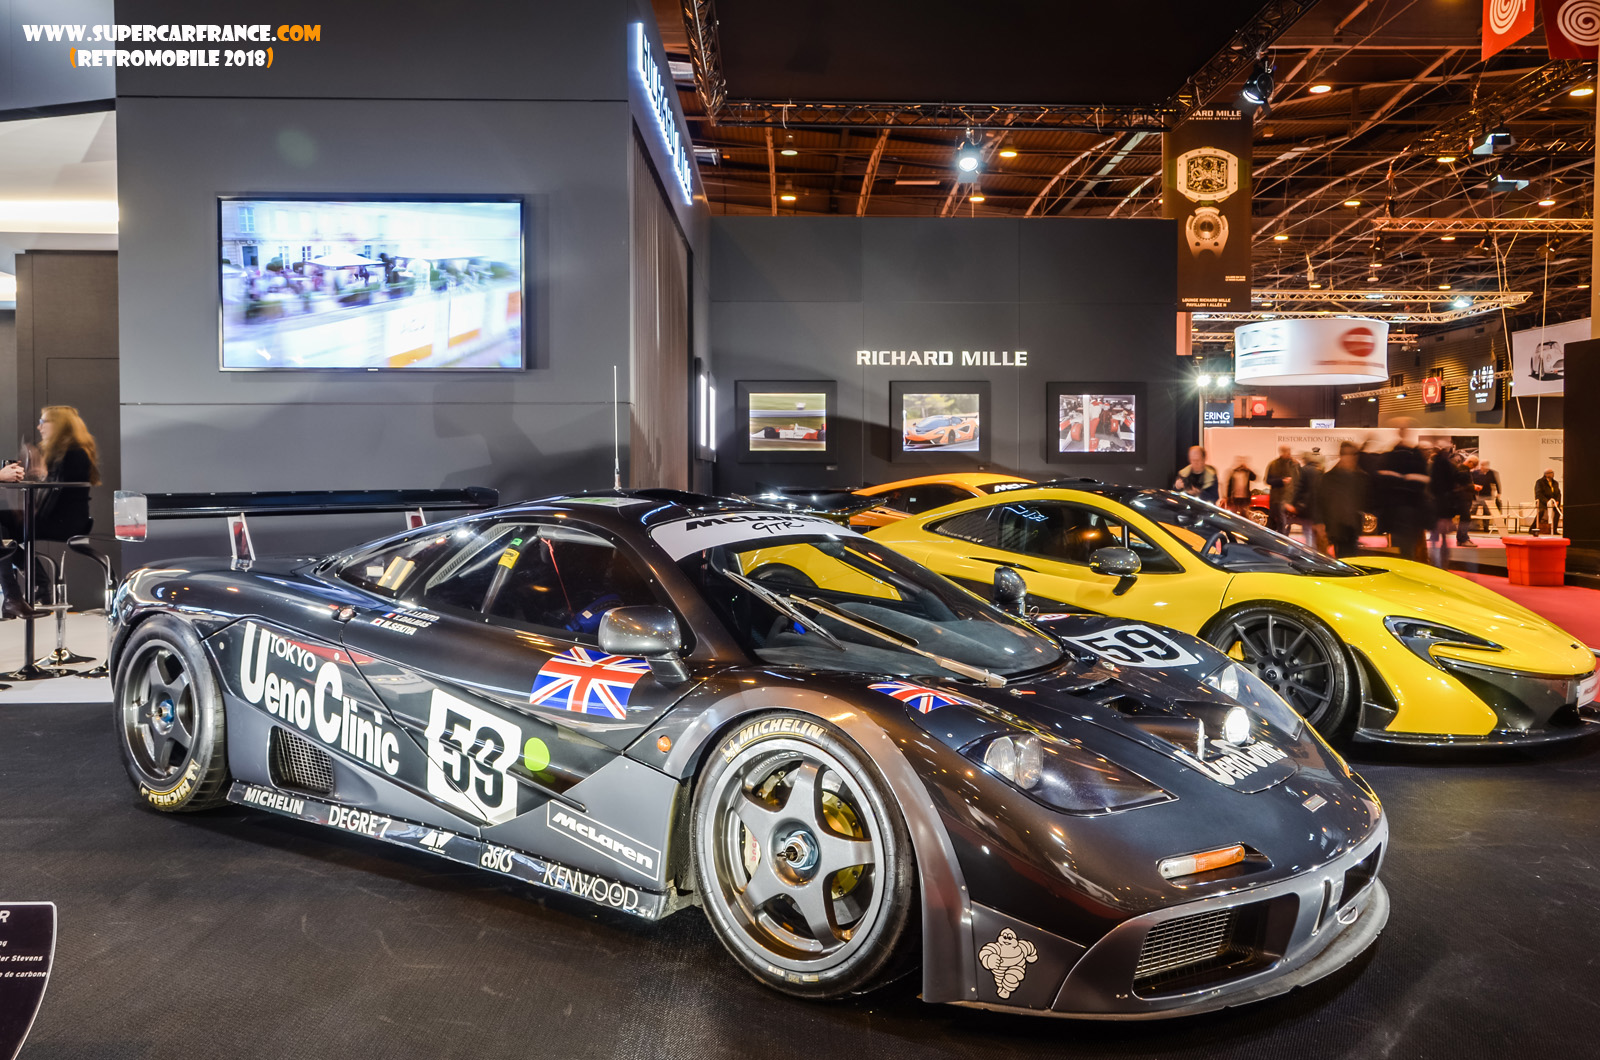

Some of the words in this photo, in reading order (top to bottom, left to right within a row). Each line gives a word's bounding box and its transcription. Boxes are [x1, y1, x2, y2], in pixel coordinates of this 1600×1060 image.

[856, 350, 954, 366] RICHARD
[961, 351, 1028, 367] MILLE
[1204, 411, 1231, 420] ERING
[751, 522, 804, 534] GTR
[269, 633, 316, 673] TOKYO
[1077, 629, 1181, 663] 59
[240, 620, 311, 731] Ueno
[314, 661, 400, 776] Clinic
[738, 718, 826, 745] MICHELIN
[437, 707, 506, 809] 59
[243, 787, 304, 815] MICHELIN
[551, 810, 654, 870] McLaren
[481, 844, 516, 873] asics
[542, 862, 639, 911] KENWOOD
